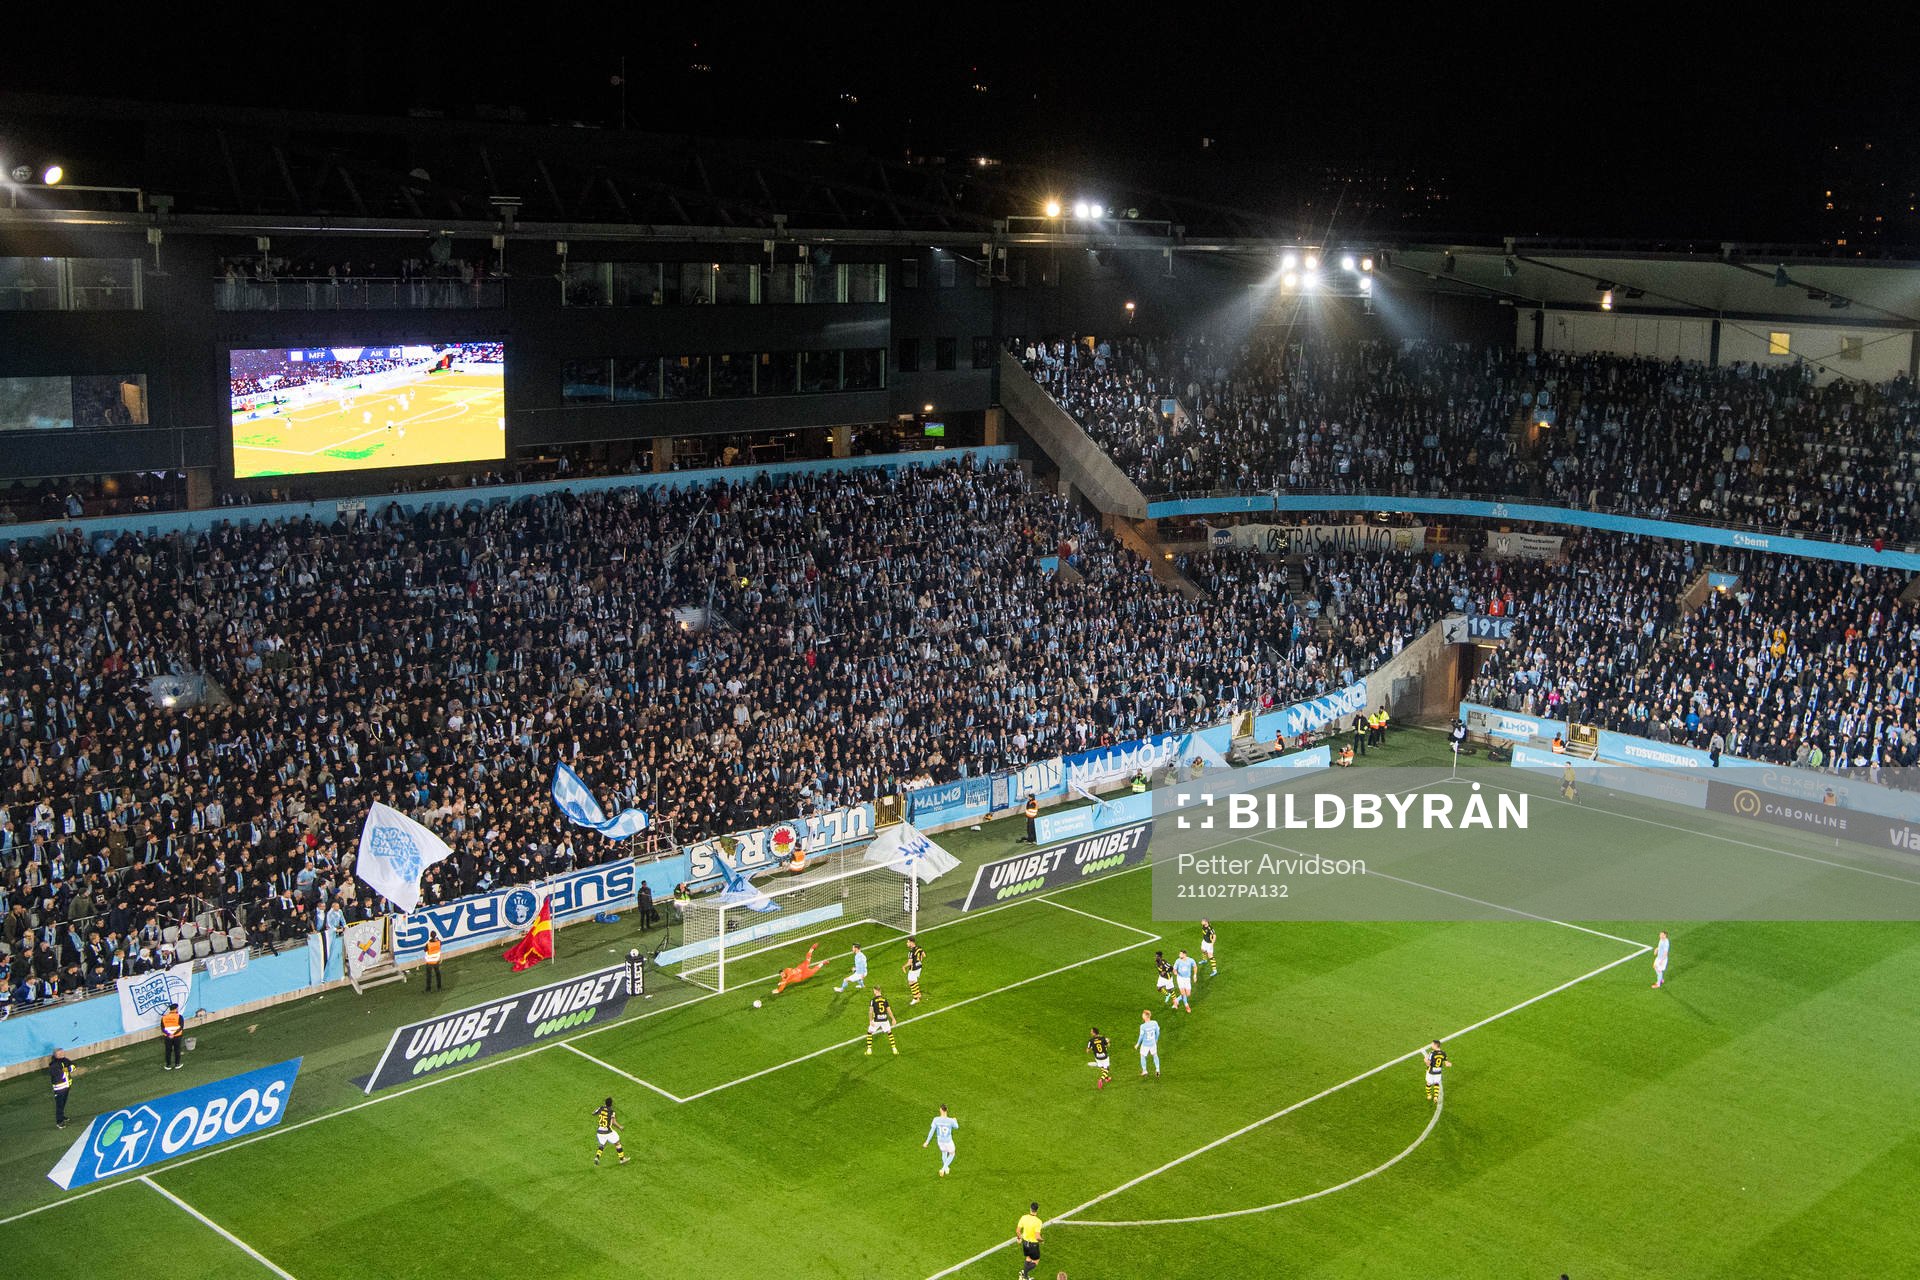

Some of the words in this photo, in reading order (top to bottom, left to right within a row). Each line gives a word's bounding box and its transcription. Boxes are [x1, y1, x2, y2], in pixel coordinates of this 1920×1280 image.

[308, 351, 326, 359] MFF
[370, 350, 384, 358] AIK
[1070, 737, 1155, 786] MALMÖ
[1015, 756, 1064, 801] 1910
[1765, 804, 1848, 830] CABONLINE
[1074, 826, 1146, 866] UNIBET
[989, 848, 1068, 890] UNIBET
[208, 950, 248, 977] 1312
[634, 962, 643, 994] SELECT
[526, 971, 627, 1024] UNIBET
[878, 1002, 885, 1013] 5
[405, 1001, 518, 1060] UNIBET
[1095, 1043, 1103, 1053] 8
[1435, 1058, 1442, 1068] 9
[161, 1080, 286, 1154] OBOS
[598, 1115, 608, 1128] 25
